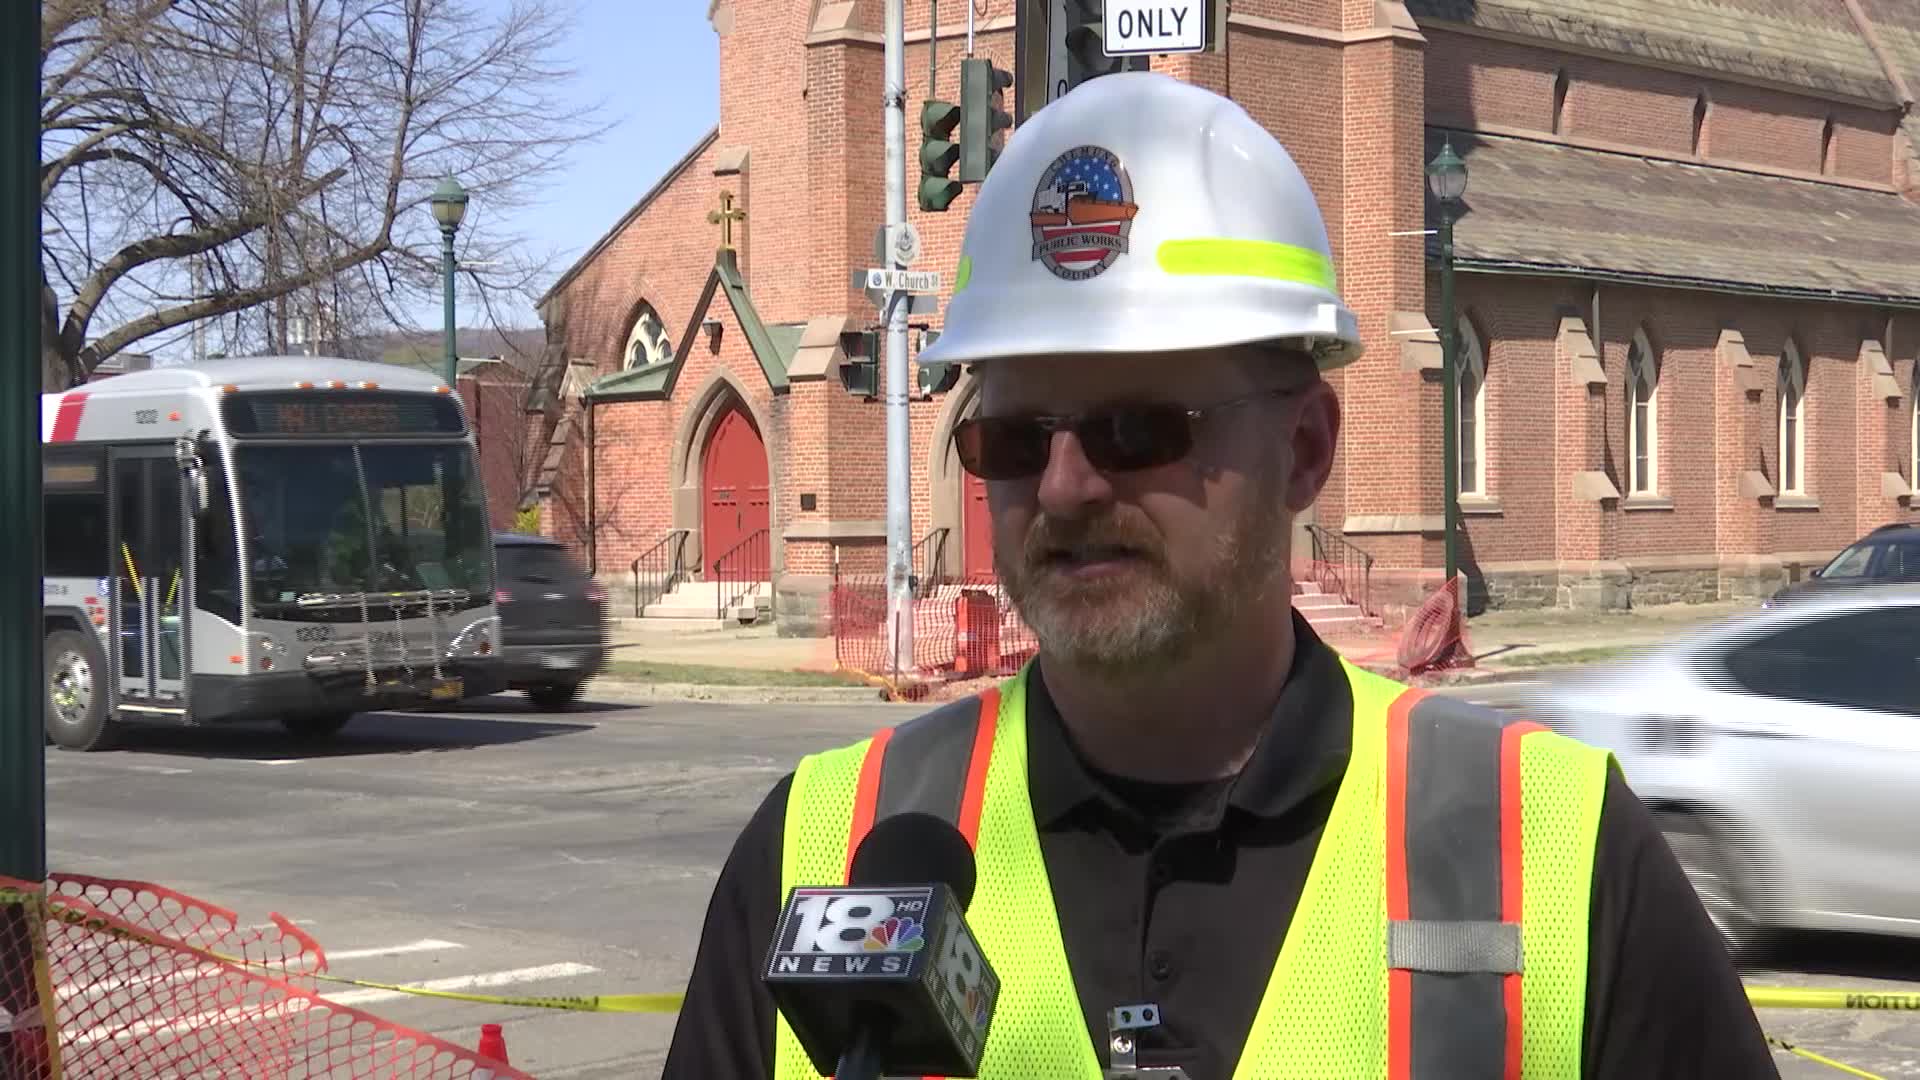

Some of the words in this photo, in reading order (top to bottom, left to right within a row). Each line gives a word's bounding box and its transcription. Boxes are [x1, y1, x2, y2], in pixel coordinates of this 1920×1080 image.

[1118, 7, 1189, 39] ONLY
[1039, 235, 1079, 253] PUBLIC
[1081, 234, 1121, 247] WORKS
[885, 271, 896, 288] W.
[898, 272, 929, 289] Church
[135, 409, 159, 424] 1202
[295, 626, 331, 642] 1202
[896, 901, 923, 912] HD
[791, 894, 895, 953] 18
[778, 956, 903, 972] NEWS
